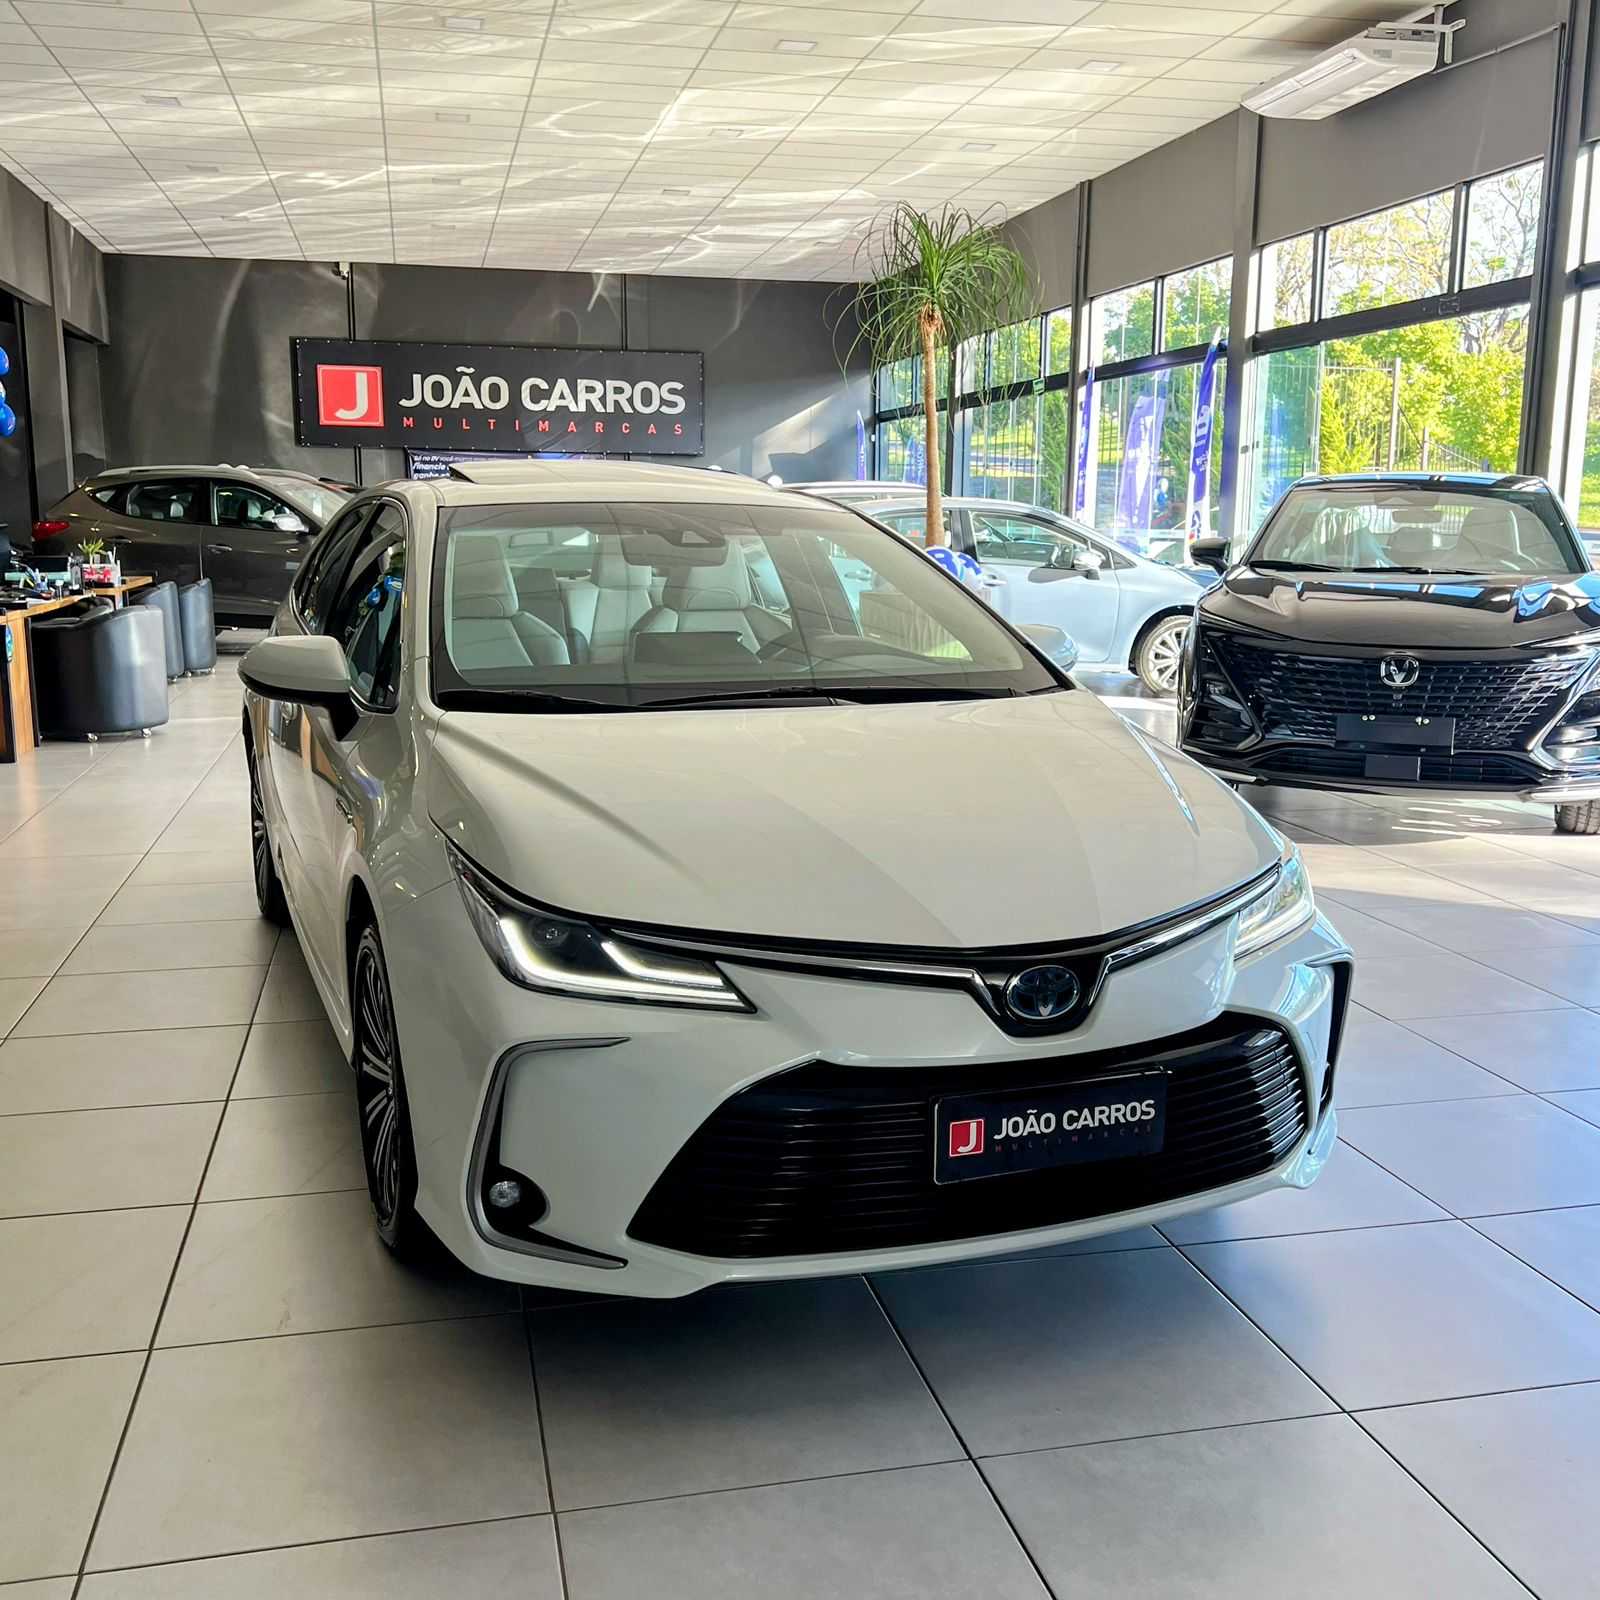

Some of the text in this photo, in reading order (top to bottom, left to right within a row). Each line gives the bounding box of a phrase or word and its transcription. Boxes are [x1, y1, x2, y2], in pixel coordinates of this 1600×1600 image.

[334, 372, 368, 420] J
[398, 366, 686, 415] JOÃO CARROS
[402, 417, 683, 435] MULTIMARCAS
[956, 1121, 977, 1153] J
[993, 1099, 1156, 1140] JOÃO CARROS
